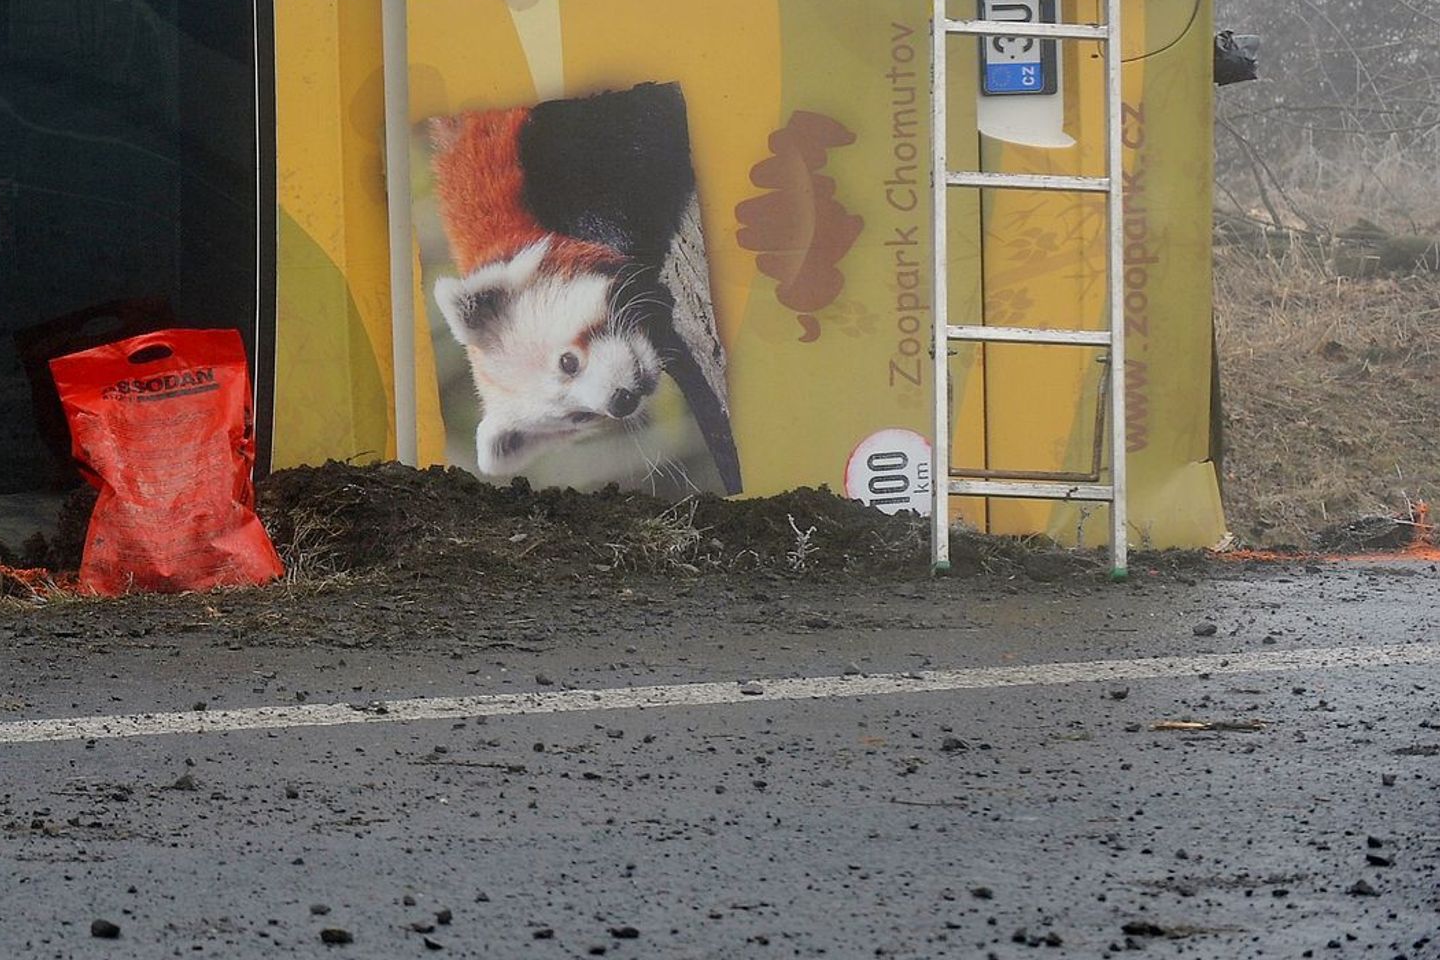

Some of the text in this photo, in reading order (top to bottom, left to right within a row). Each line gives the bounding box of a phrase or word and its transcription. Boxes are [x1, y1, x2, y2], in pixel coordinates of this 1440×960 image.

[1022, 66, 1035, 86] CZ
[884, 21, 930, 388] Zoopark Chomutov
[867, 451, 910, 506] 100
[913, 462, 929, 494] km
